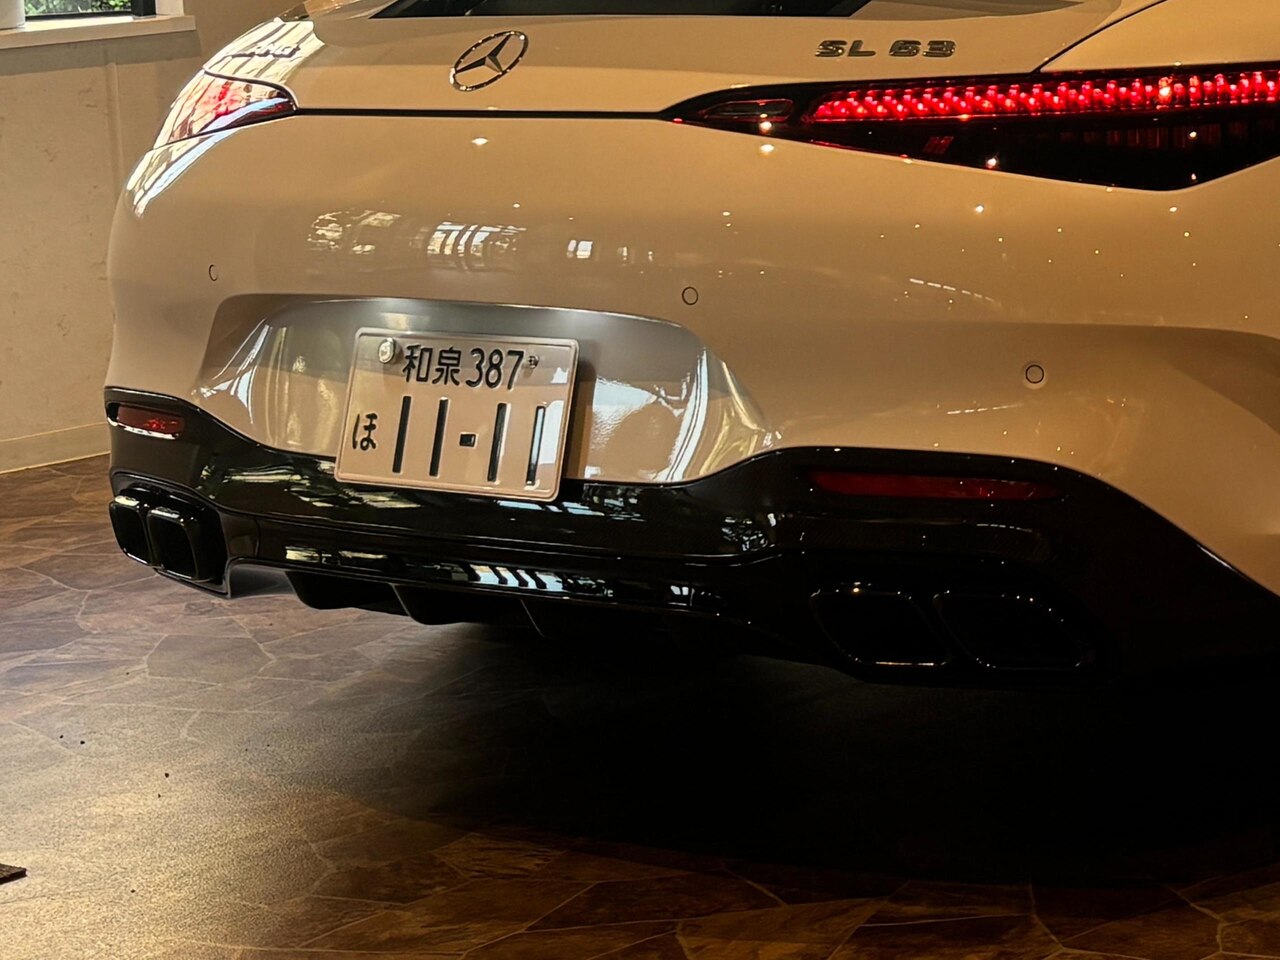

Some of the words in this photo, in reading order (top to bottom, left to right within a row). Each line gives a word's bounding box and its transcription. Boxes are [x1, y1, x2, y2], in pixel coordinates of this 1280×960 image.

[815, 40, 876, 57] SL
[888, 40, 957, 57] 63
[352, 413, 378, 451] ほ
[392, 395, 546, 486] 11-11
